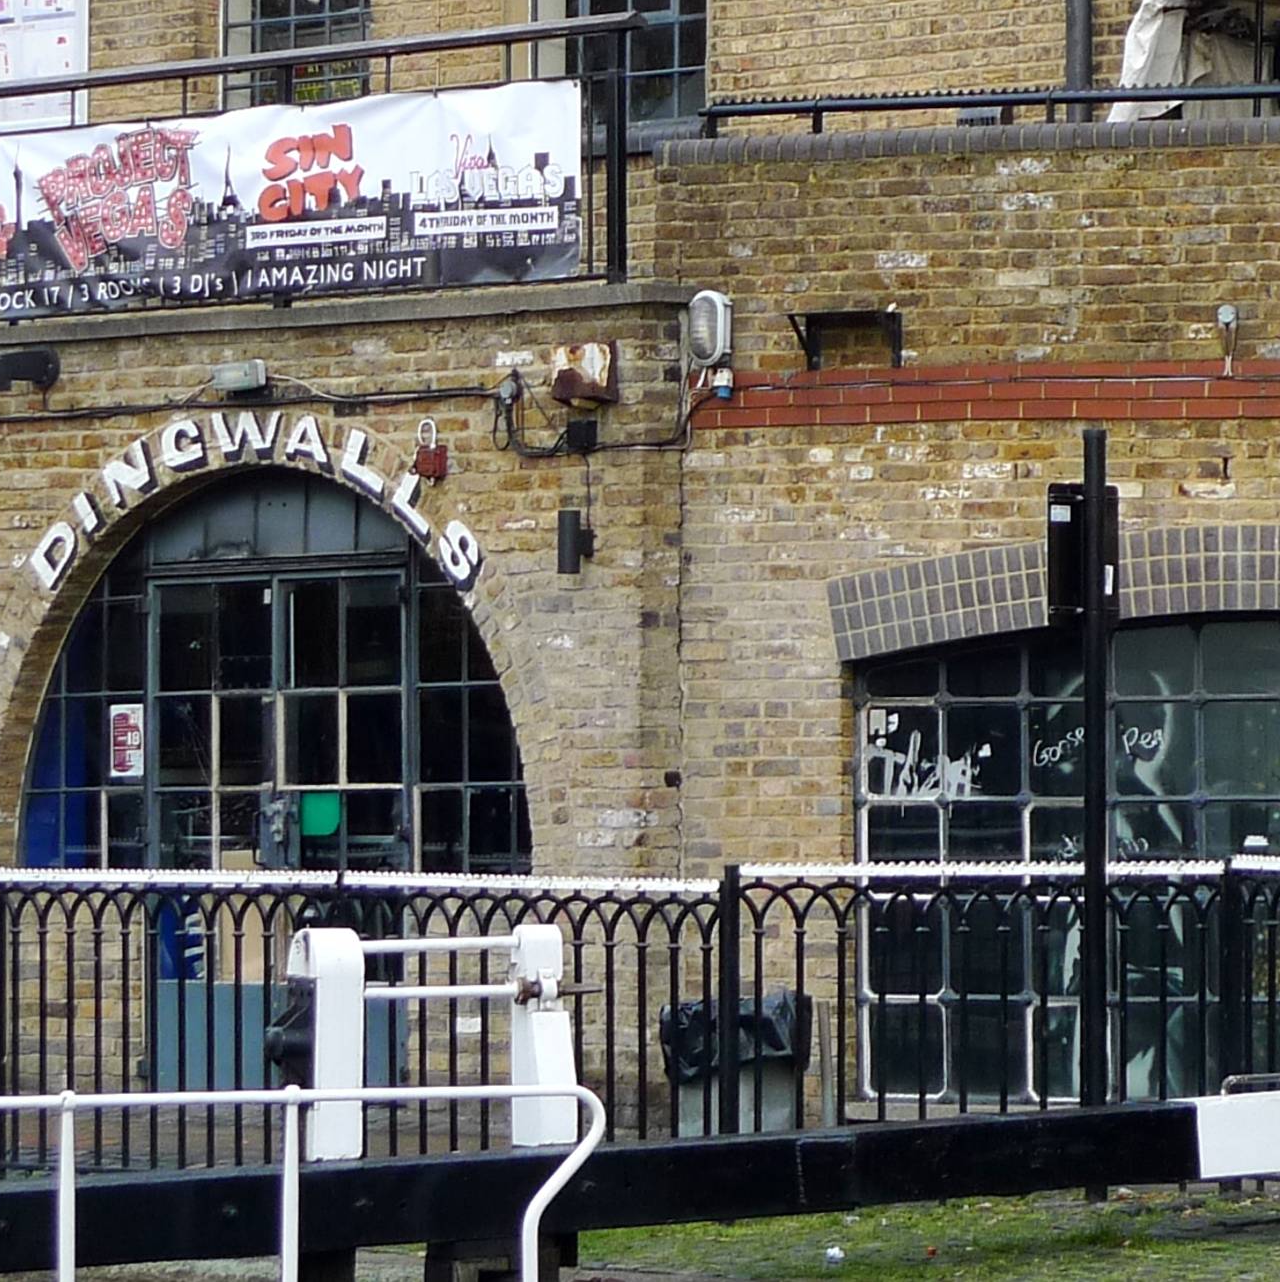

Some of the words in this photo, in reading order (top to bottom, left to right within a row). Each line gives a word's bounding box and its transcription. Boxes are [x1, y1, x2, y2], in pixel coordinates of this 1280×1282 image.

[38, 128, 200, 227] PROJECT
[262, 123, 352, 181] SIN
[258, 164, 364, 222] CITY
[462, 163, 565, 201] VEGAS
[55, 186, 192, 272] VEGAS
[250, 230, 268, 240] 3RD
[269, 228, 308, 240] FRIDAY
[310, 227, 322, 237] OF
[324, 226, 343, 236] THE
[345, 223, 384, 234] MONTH
[509, 211, 554, 224] MONTH
[44, 287, 60, 306] 17
[81, 283, 89, 302] 3
[172, 275, 181, 293] 3
[190, 272, 224, 298] DJ's
[258, 263, 355, 288] AMAZING
[363, 257, 427, 280] NIGHT
[28, 410, 487, 593] DINGWALLS
